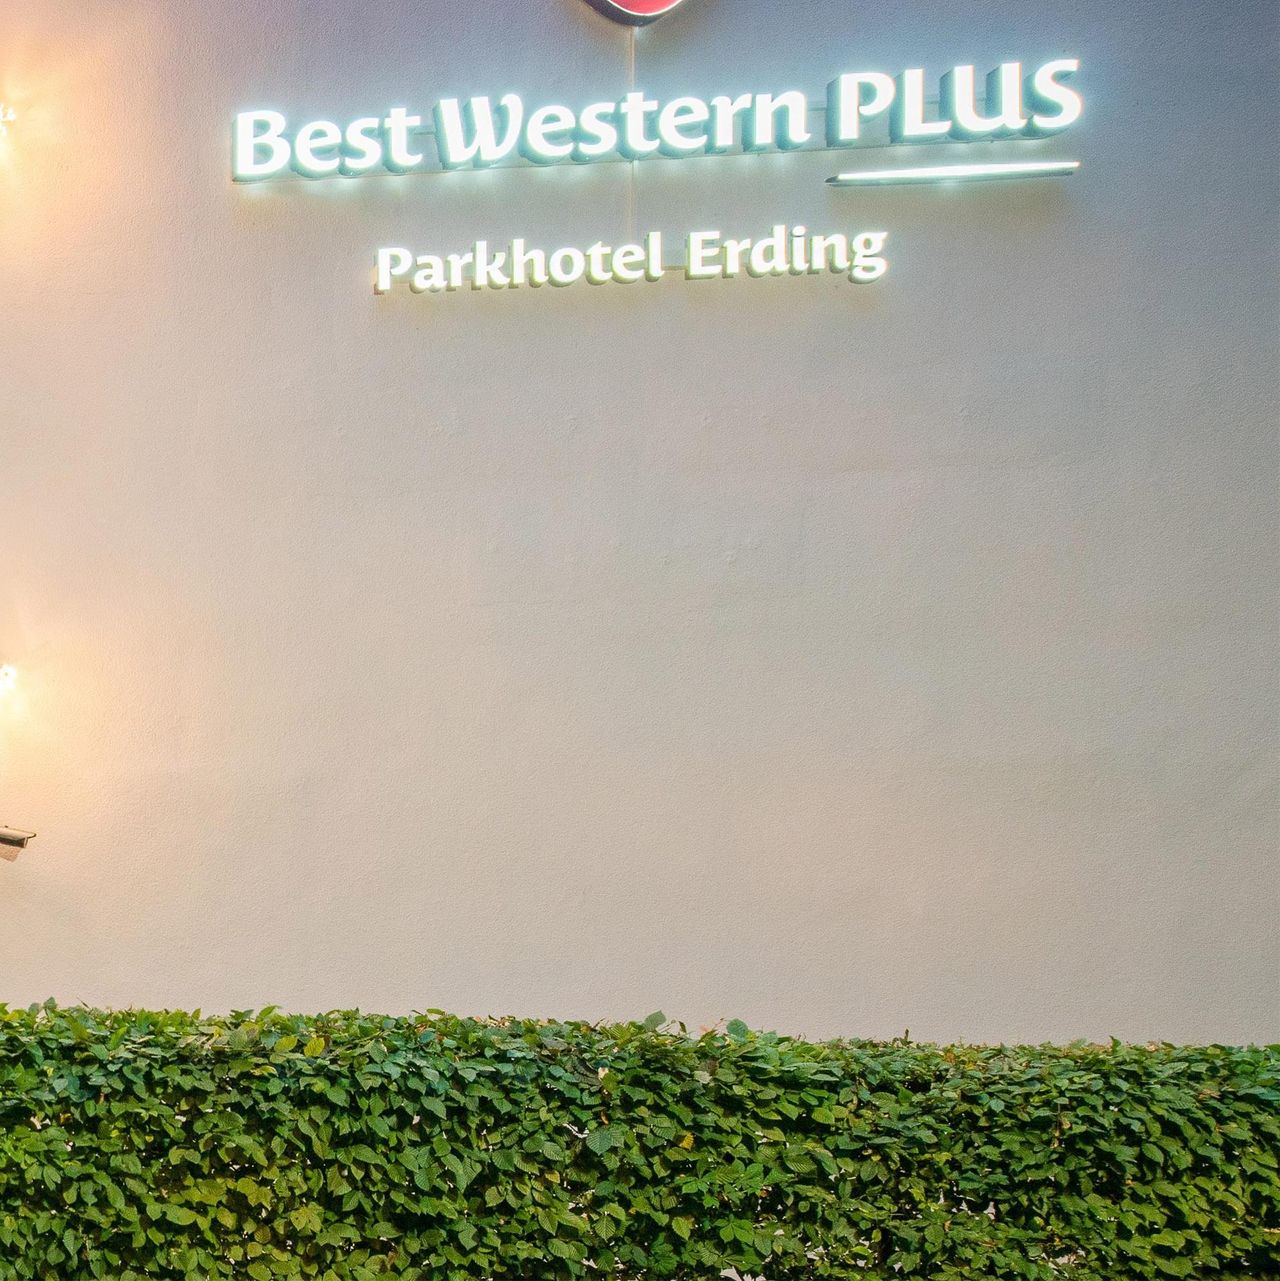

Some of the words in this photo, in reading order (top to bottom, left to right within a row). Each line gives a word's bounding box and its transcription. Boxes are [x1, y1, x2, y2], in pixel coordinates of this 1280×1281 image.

[235, 105, 423, 179] Best
[438, 90, 808, 163] Western
[833, 58, 1084, 141] PLUS
[374, 230, 663, 293] Parkhotel
[686, 225, 889, 283] Erding
